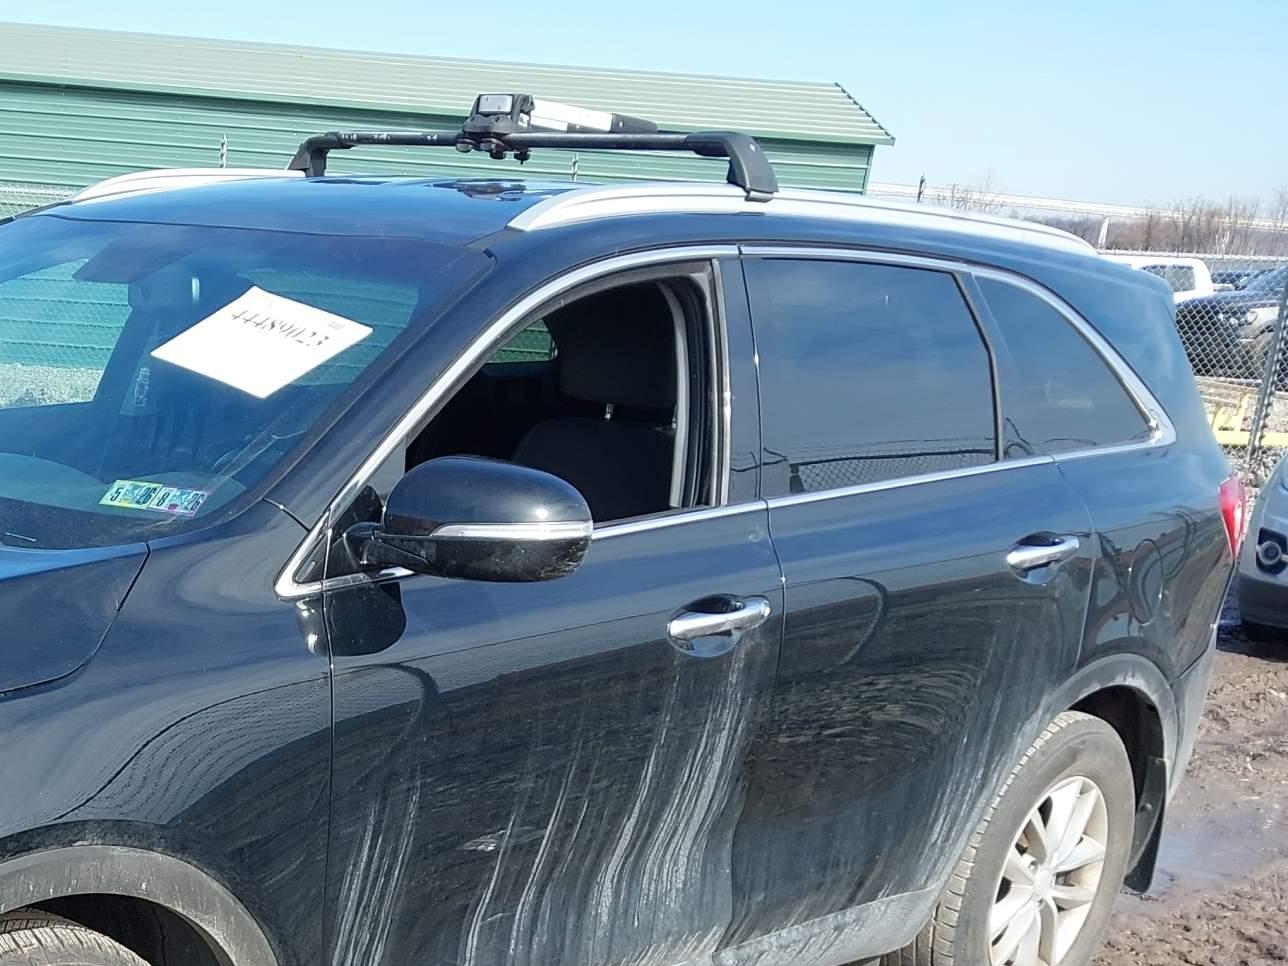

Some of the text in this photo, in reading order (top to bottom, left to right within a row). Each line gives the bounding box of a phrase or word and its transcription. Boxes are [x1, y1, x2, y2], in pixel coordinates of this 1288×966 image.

[109, 486, 158, 505] 5 26
[156, 492, 205, 511] 8 26
